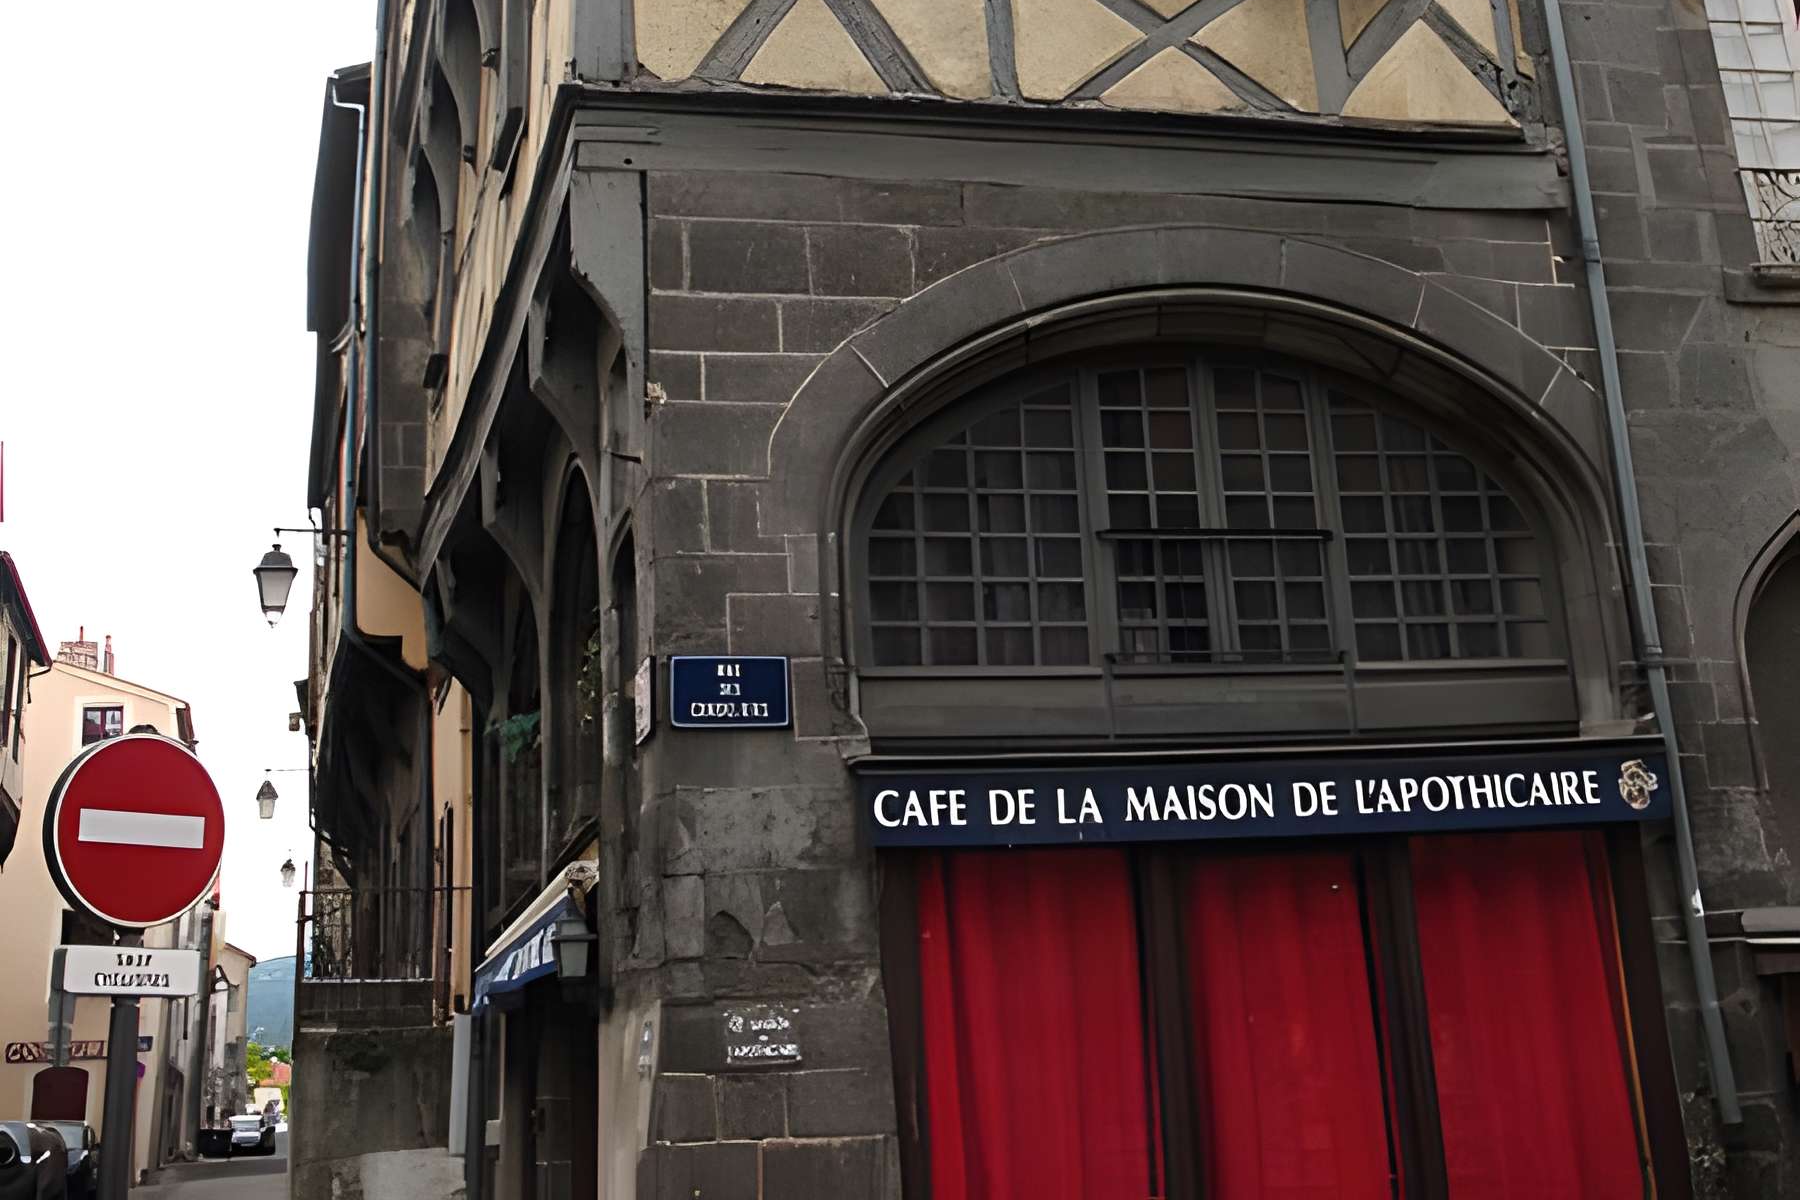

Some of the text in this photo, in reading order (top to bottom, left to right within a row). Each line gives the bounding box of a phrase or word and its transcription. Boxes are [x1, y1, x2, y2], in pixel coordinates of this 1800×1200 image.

[873, 770, 1601, 828] CAFE DE LA MAISON DE L'APOTHICAIRE
